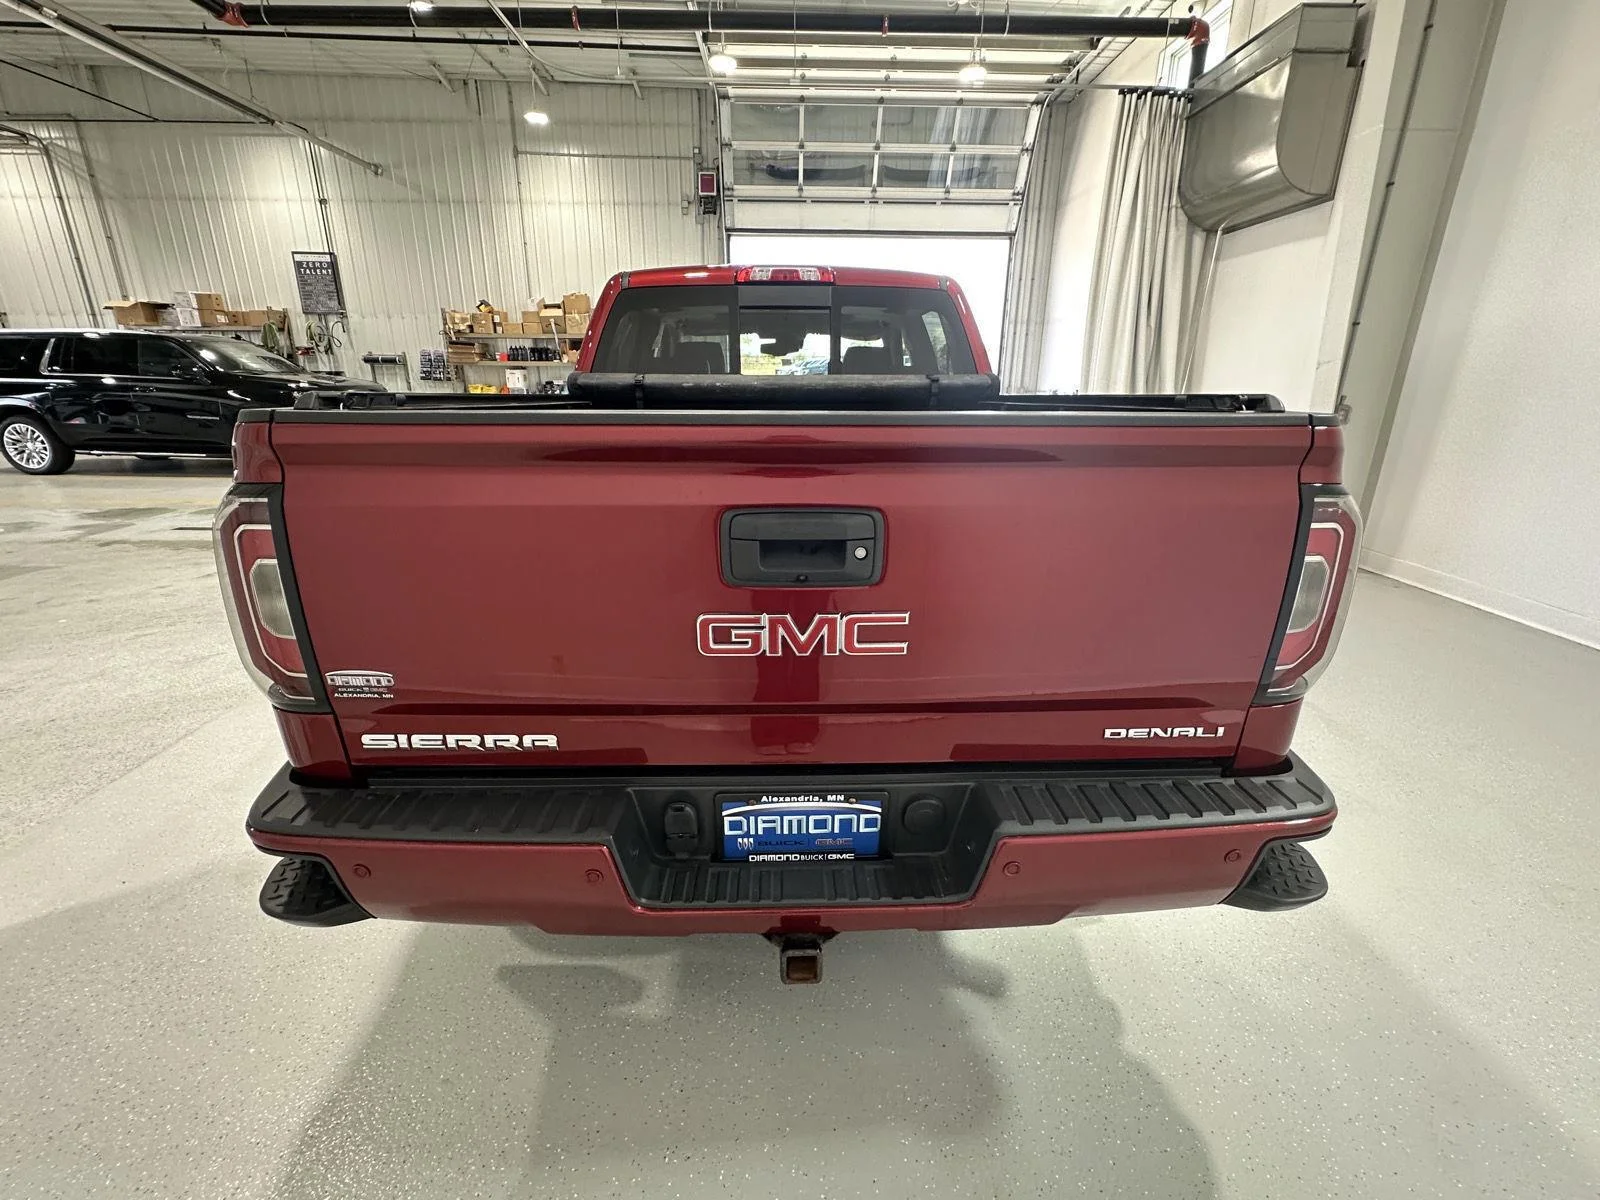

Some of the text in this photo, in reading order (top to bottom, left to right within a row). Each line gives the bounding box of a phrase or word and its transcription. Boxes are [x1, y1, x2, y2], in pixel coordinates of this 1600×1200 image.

[696, 611, 911, 657] GMC
[326, 675, 394, 686] DIAMOND
[1103, 726, 1225, 739] DENALI
[360, 733, 559, 751] SIERRA
[826, 794, 845, 802] MN
[723, 814, 882, 836] DIAMOND
[815, 837, 853, 846] GMC
[748, 853, 800, 862] DIAMOND
